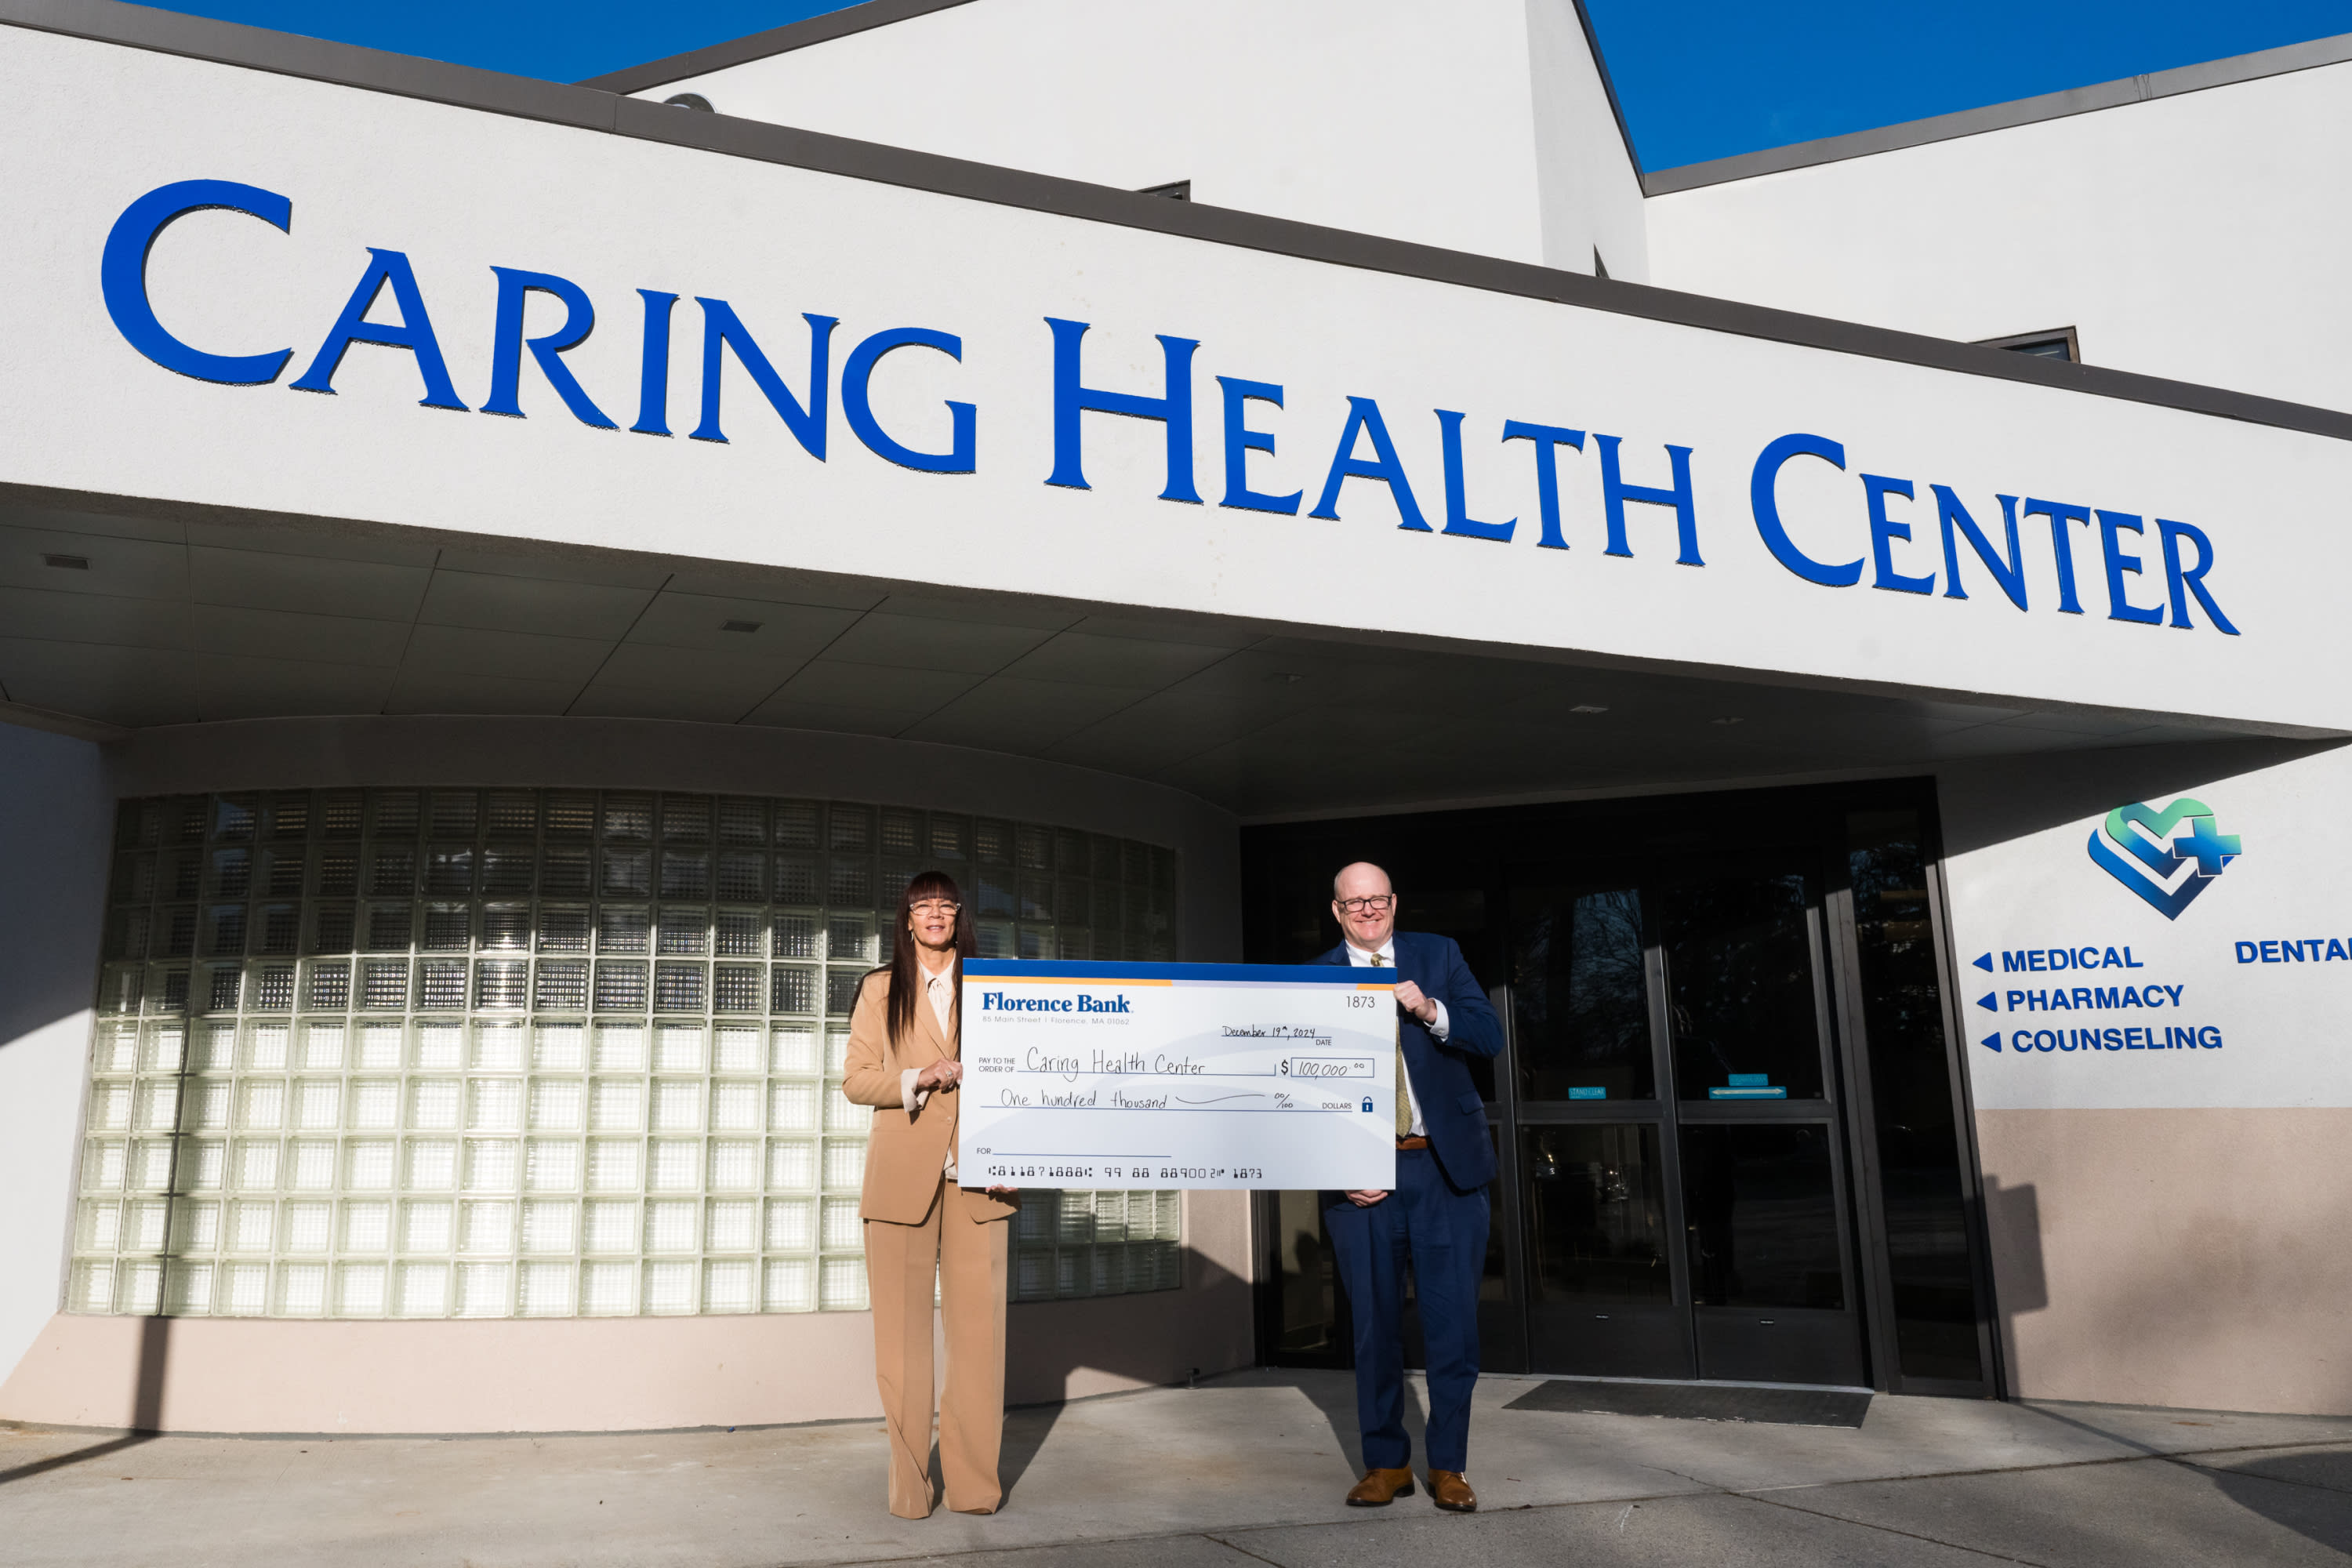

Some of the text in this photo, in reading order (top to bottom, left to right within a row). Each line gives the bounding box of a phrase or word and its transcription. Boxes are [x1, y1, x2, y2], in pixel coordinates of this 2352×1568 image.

[101, 179, 2241, 637] CARING HEALTH CENTER
[2002, 946, 2143, 972] MEDICAL
[2234, 938, 2352, 964] DENTA
[982, 992, 1131, 1014] Florence Bank
[1346, 996, 1375, 1008] 1873
[2006, 985, 2184, 1012] PHARMACY
[1222, 1024, 1266, 1038] December
[1294, 1028, 1316, 1039] 2024
[2012, 1025, 2223, 1052] COUNSELING
[1027, 1047, 1206, 1082] Caring Health Center
[1281, 1059, 1289, 1075] $
[1000, 1088, 1031, 1107] One
[1042, 1089, 1096, 1107] hundred
[1110, 1091, 1167, 1109] thousand
[1233, 1168, 1262, 1178] 1873
